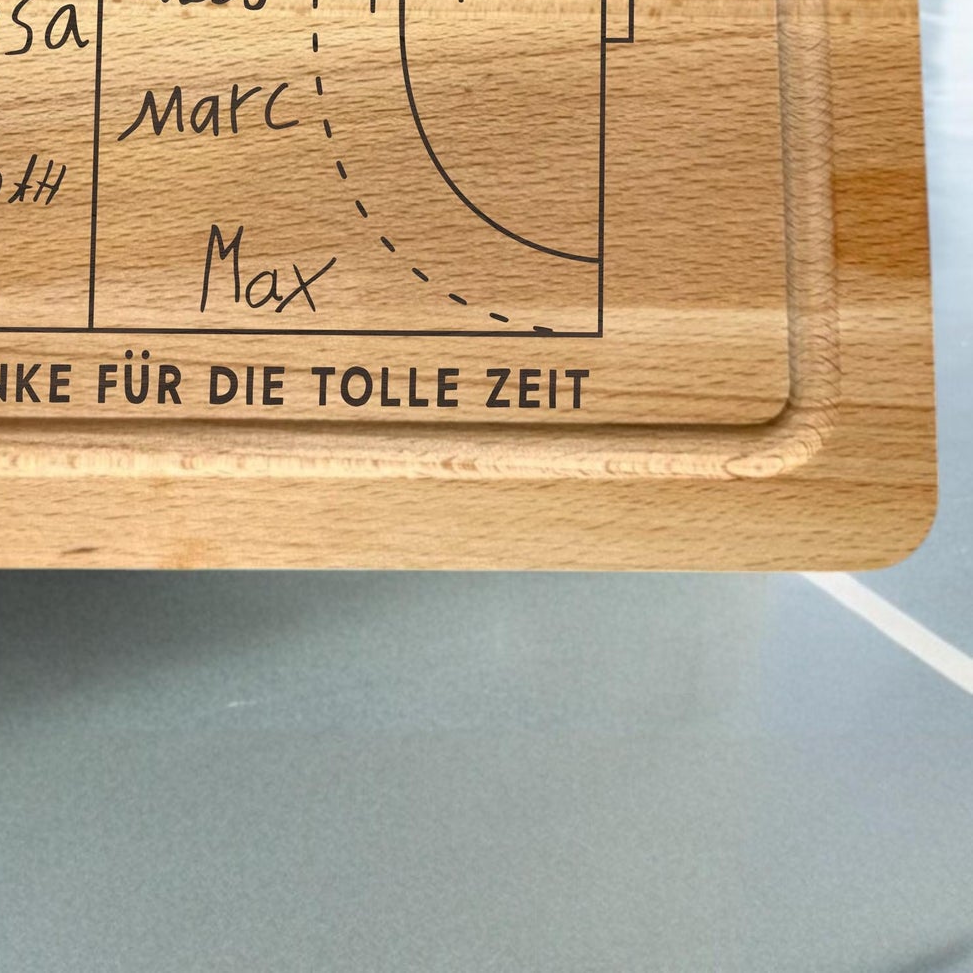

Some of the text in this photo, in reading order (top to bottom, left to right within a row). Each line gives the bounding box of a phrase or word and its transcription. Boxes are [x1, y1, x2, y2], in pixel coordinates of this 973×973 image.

[200, 224, 337, 313] Max
[97, 349, 182, 405] FÜR
[209, 365, 285, 406] DIE
[311, 366, 460, 408] TOLLE
[485, 368, 590, 409] ZEIT
